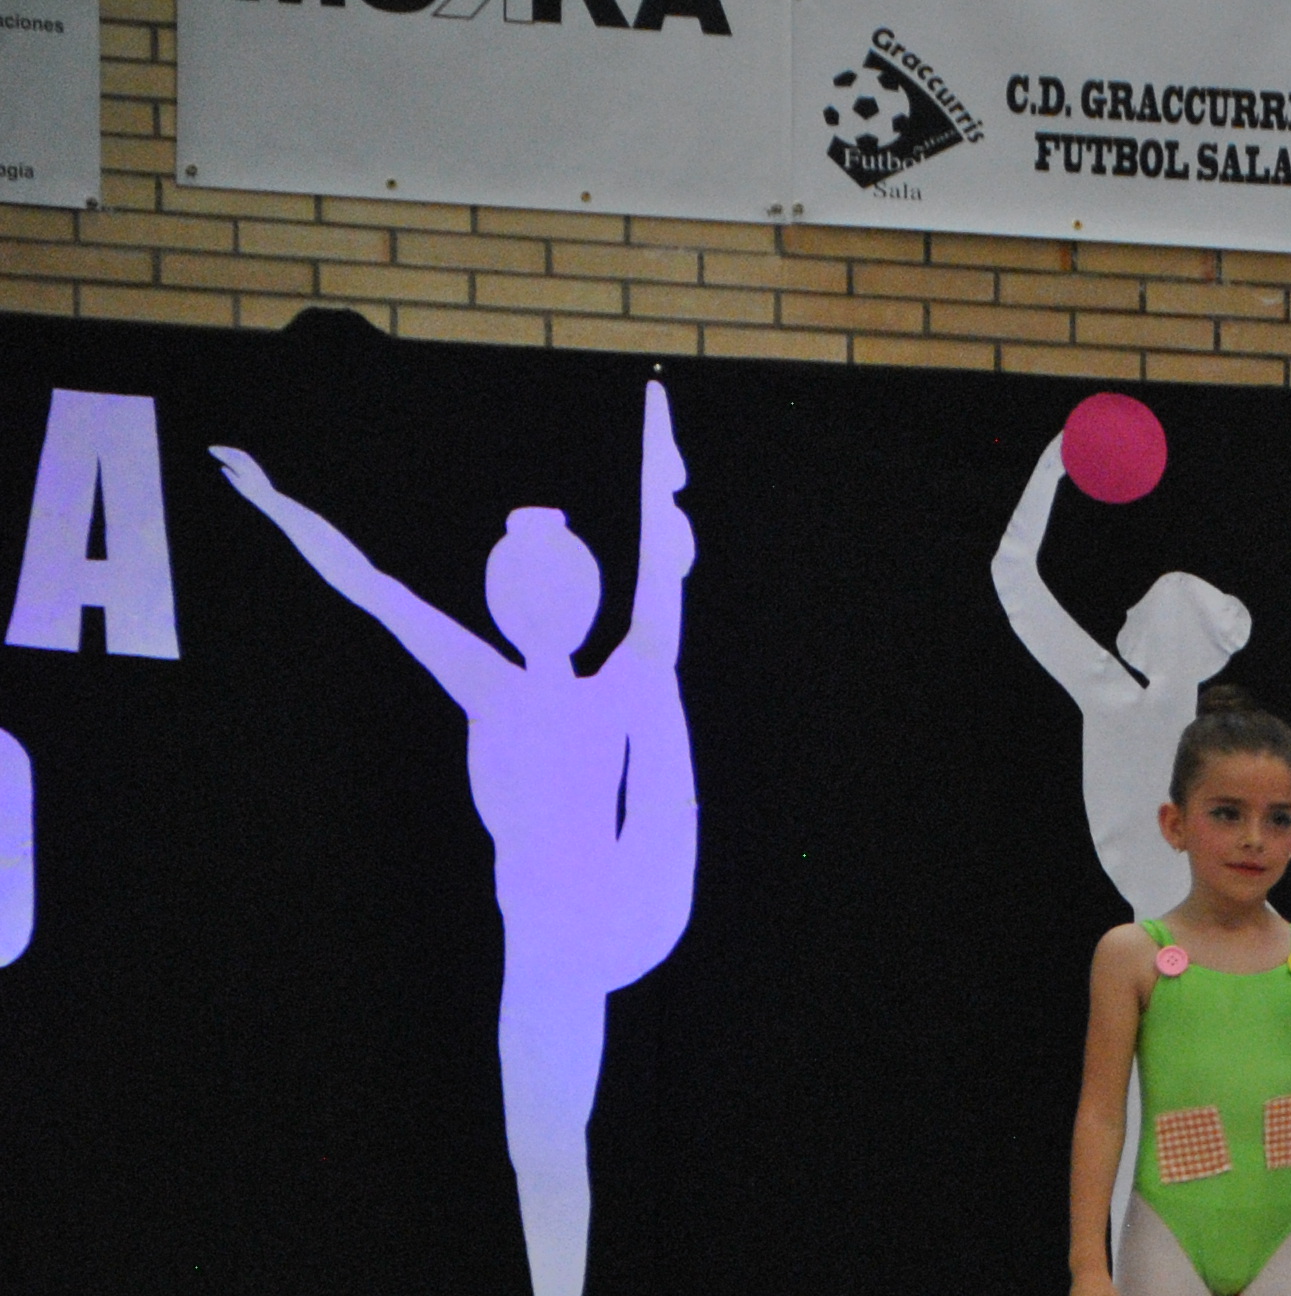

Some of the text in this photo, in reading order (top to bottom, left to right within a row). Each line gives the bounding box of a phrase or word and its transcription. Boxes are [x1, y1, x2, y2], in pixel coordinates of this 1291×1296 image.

[871, 26, 985, 143] Graccurris
[1006, 75, 1072, 116] C.D.
[1035, 132, 1189, 180] FUTBOL
[873, 181, 922, 200] Sala
